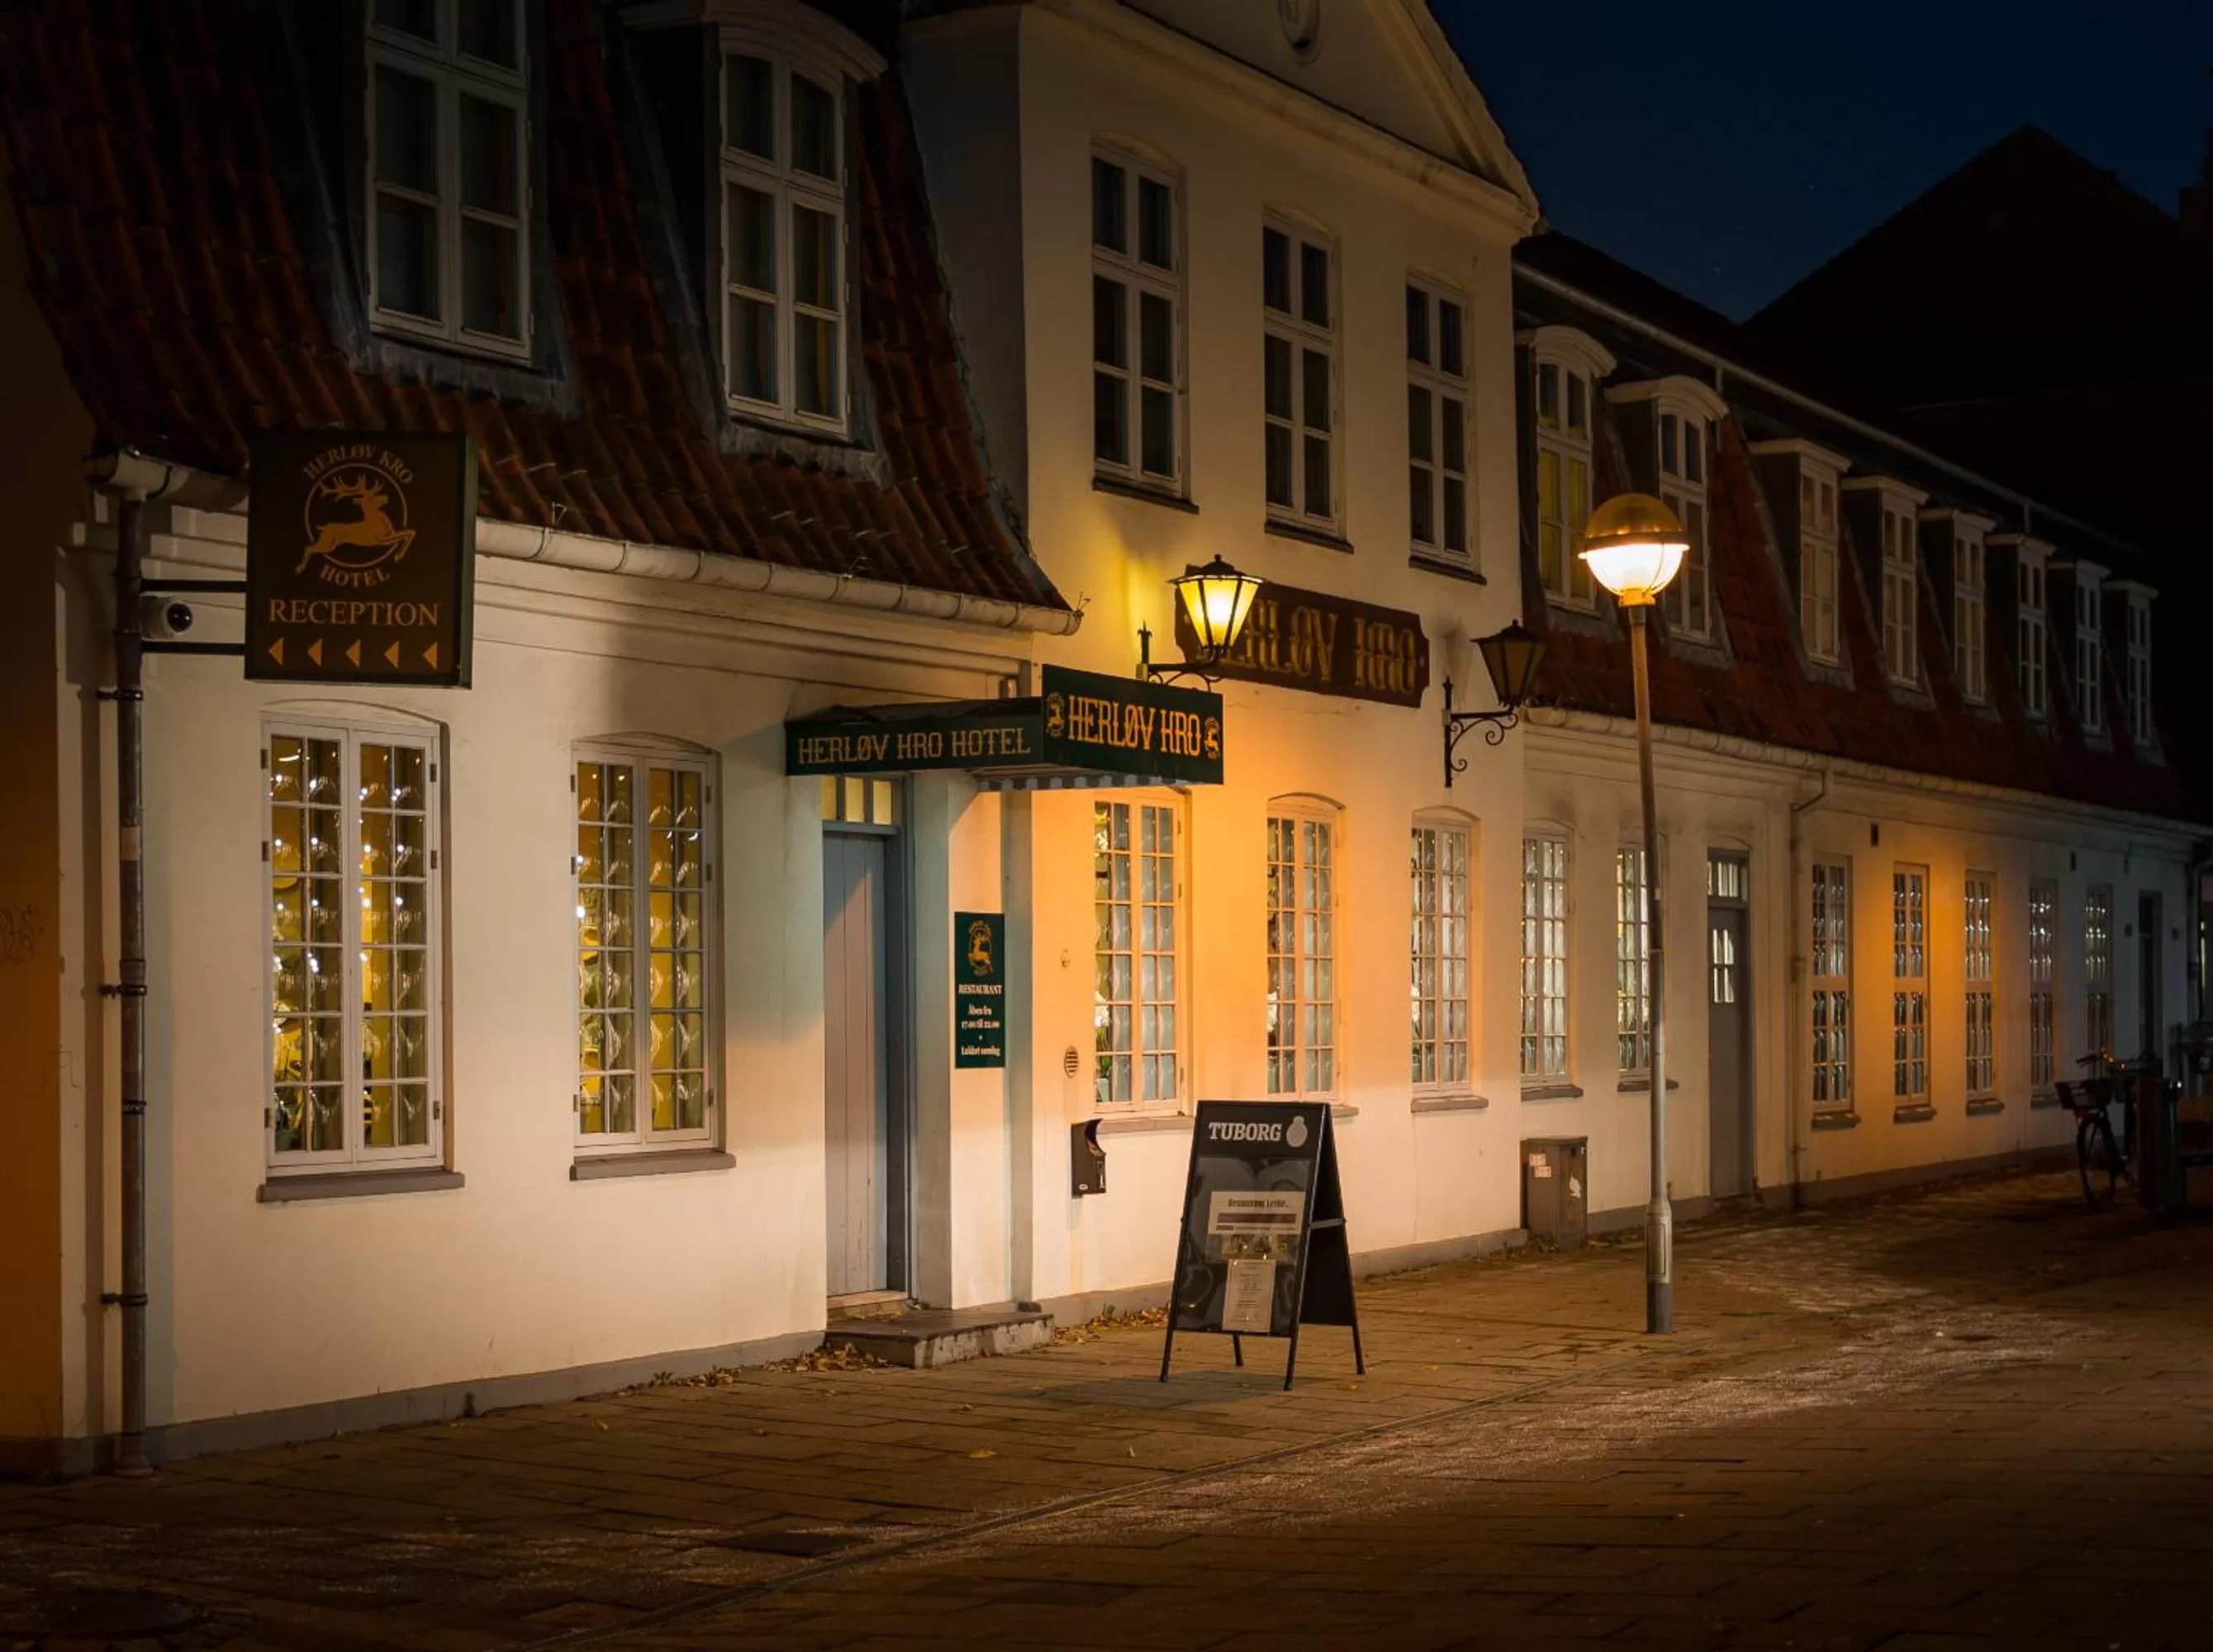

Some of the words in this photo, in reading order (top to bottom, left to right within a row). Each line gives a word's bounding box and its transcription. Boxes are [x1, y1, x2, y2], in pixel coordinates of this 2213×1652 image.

[320, 564, 391, 588] HOTEL
[269, 599, 441, 626] RECEPTION
[951, 727, 1031, 757] HOTEL
[958, 984, 1002, 995] RESTAURANT
[1208, 1122, 1282, 1142] TUBORG
